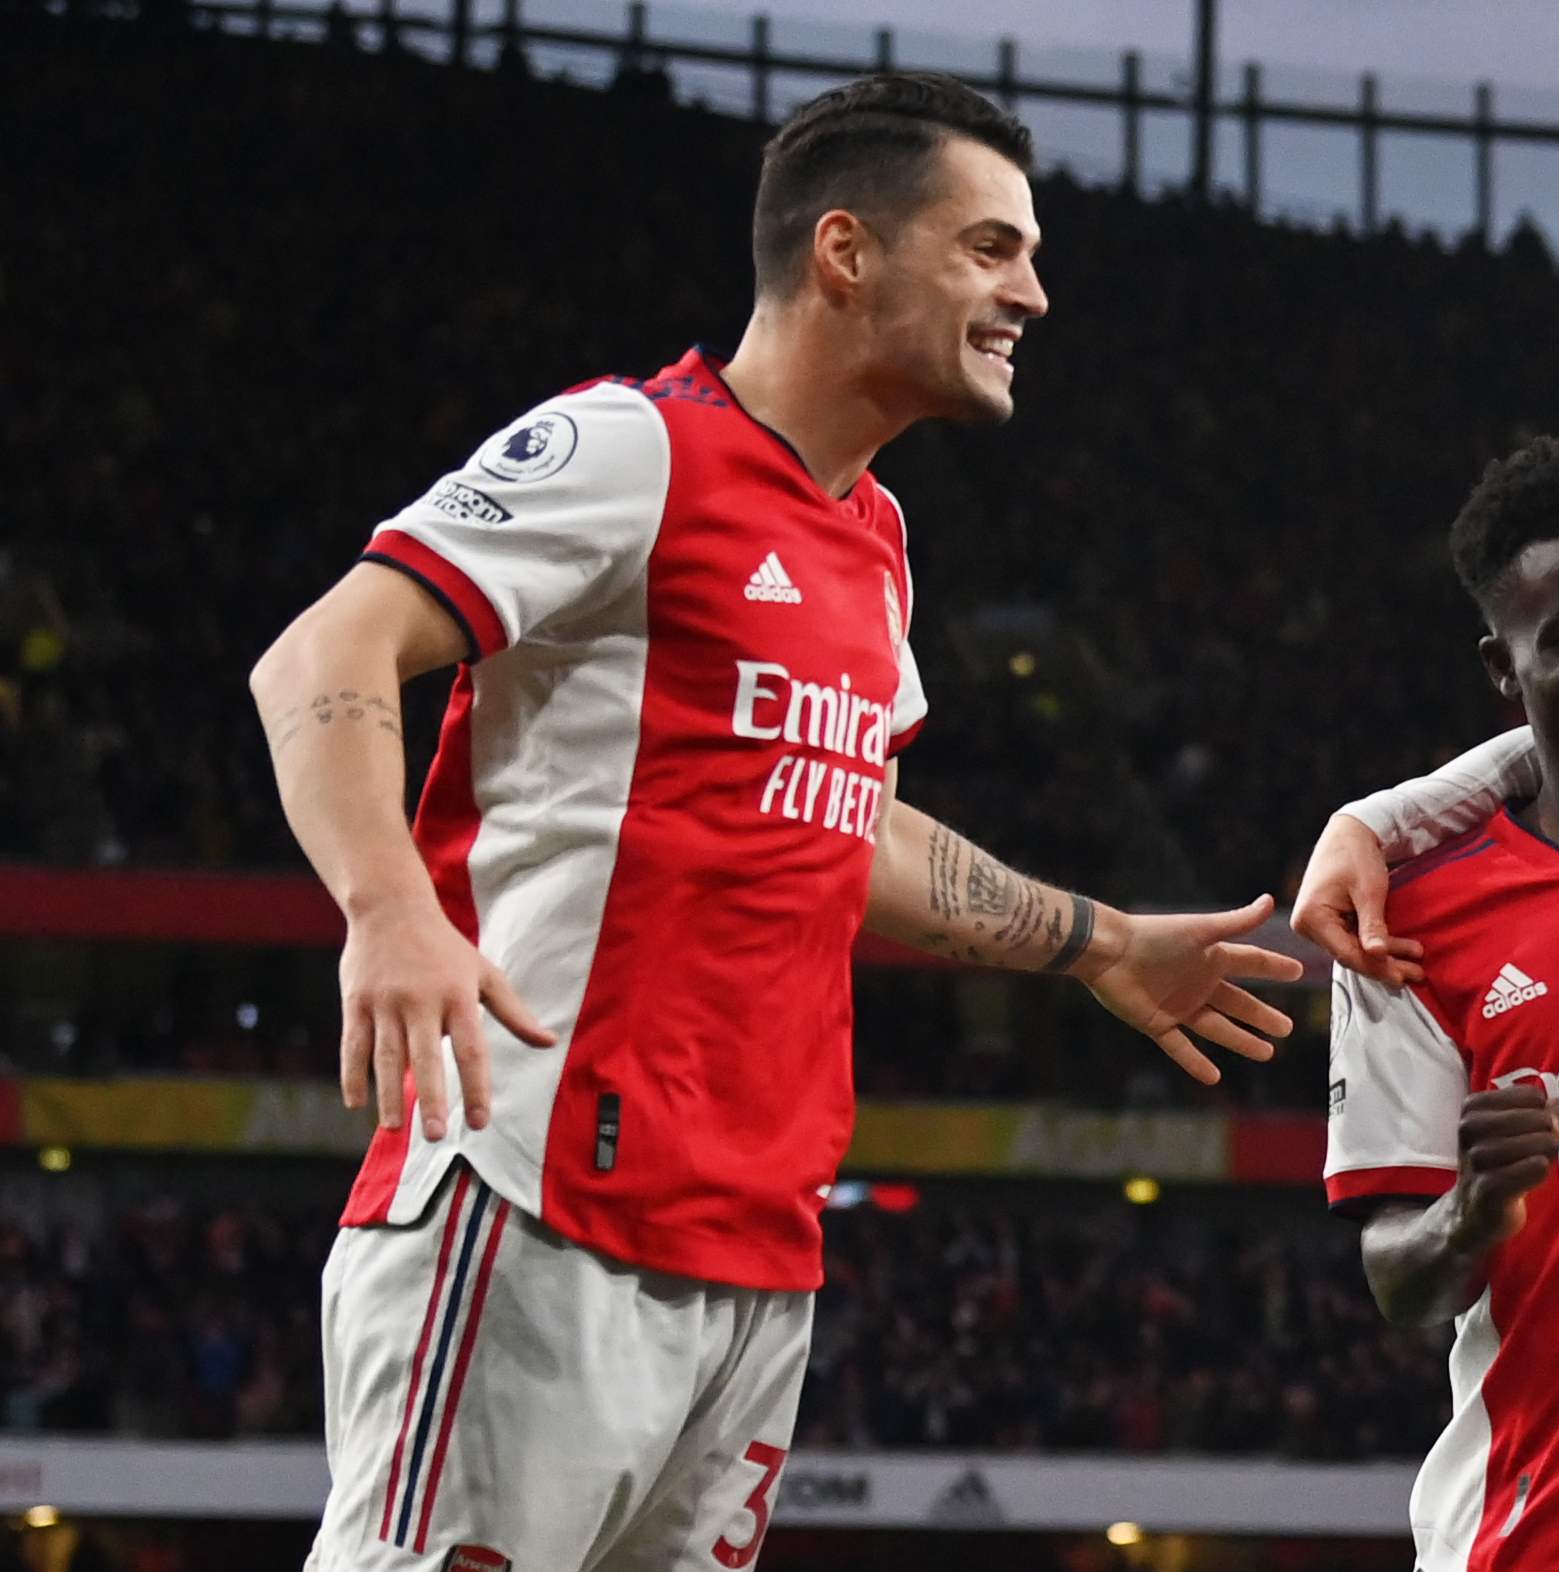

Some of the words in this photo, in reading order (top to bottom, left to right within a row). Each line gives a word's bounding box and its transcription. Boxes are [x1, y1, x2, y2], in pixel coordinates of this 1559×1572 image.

[743, 584, 802, 604] adidas
[760, 755, 828, 823] FLY
[1482, 981, 1549, 1019] adidas
